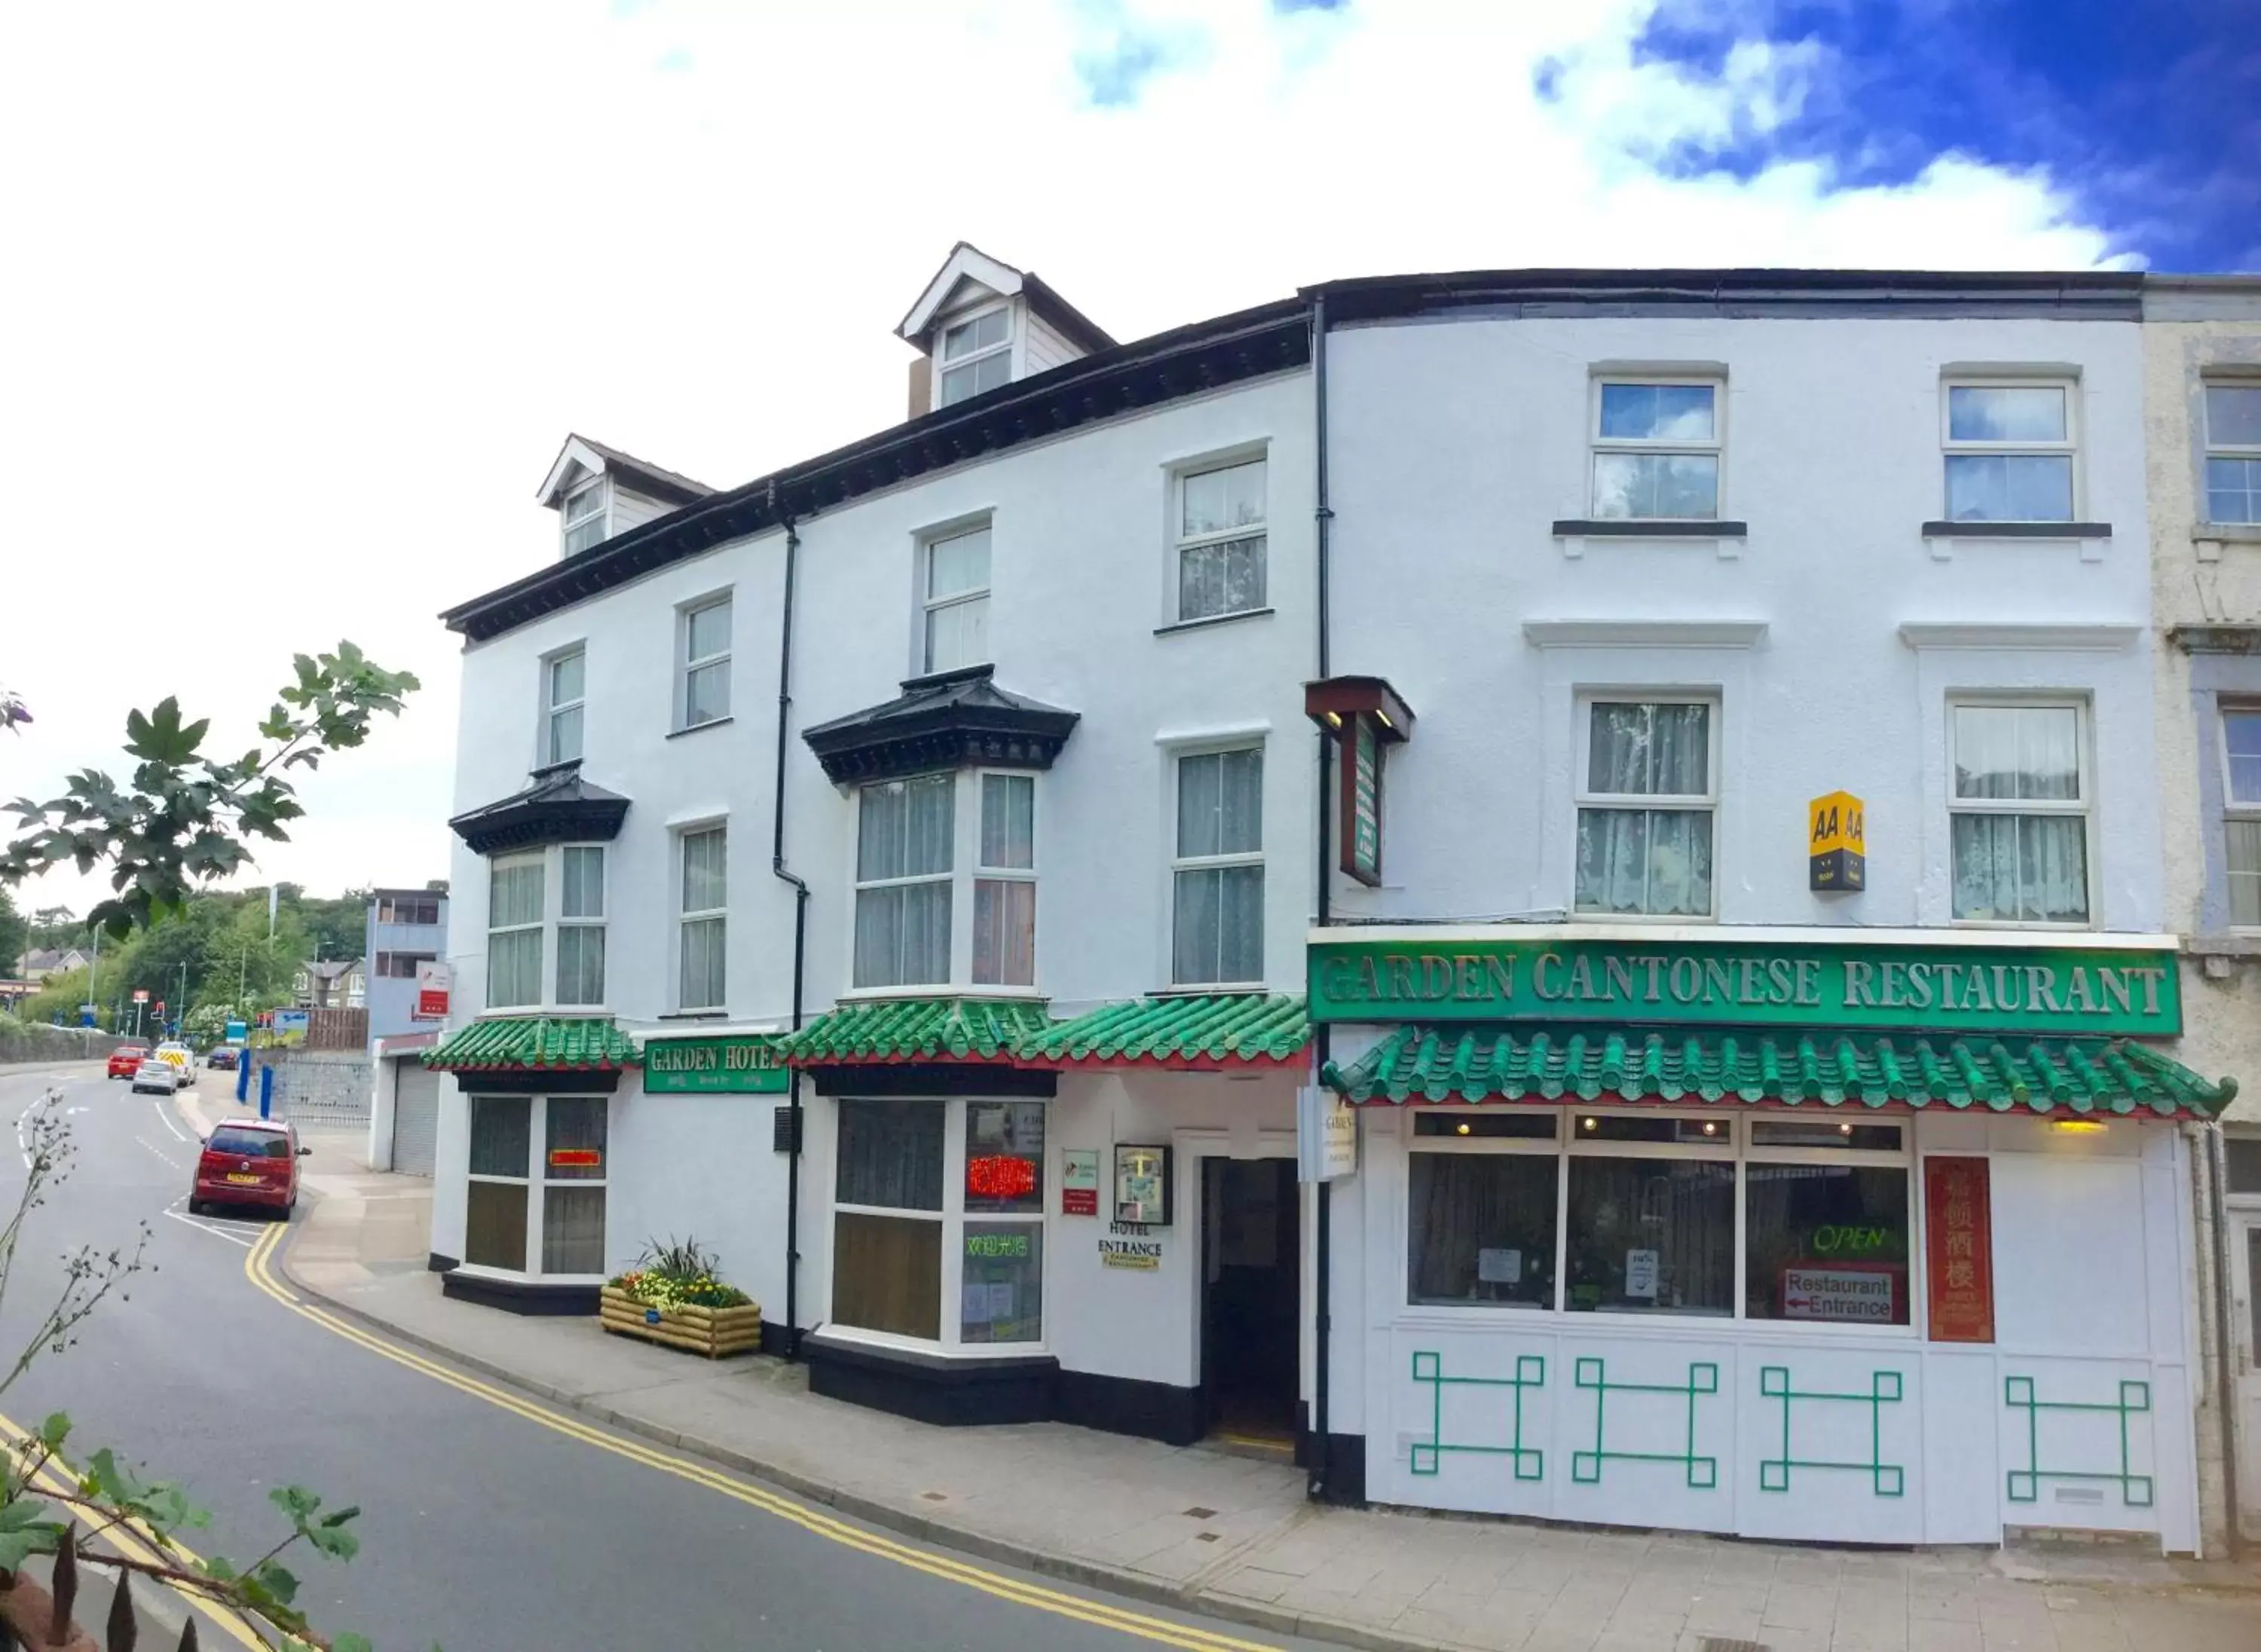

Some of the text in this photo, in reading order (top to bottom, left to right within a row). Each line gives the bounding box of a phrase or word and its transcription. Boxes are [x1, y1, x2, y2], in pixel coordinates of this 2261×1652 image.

[1813, 806, 1838, 843] AA
[1845, 807, 1862, 842] AA
[1322, 953, 2165, 1014] GARDEN CANTONESE RESTAURANT
[652, 1047, 717, 1071] GARDEN
[1109, 1222, 1150, 1236] HOTEL
[1814, 1225, 1887, 1251] OPEN
[1098, 1240, 1162, 1256] ENTRANCE
[1788, 1274, 1889, 1296] Restaurant
[1809, 1295, 1889, 1315] Entrance
